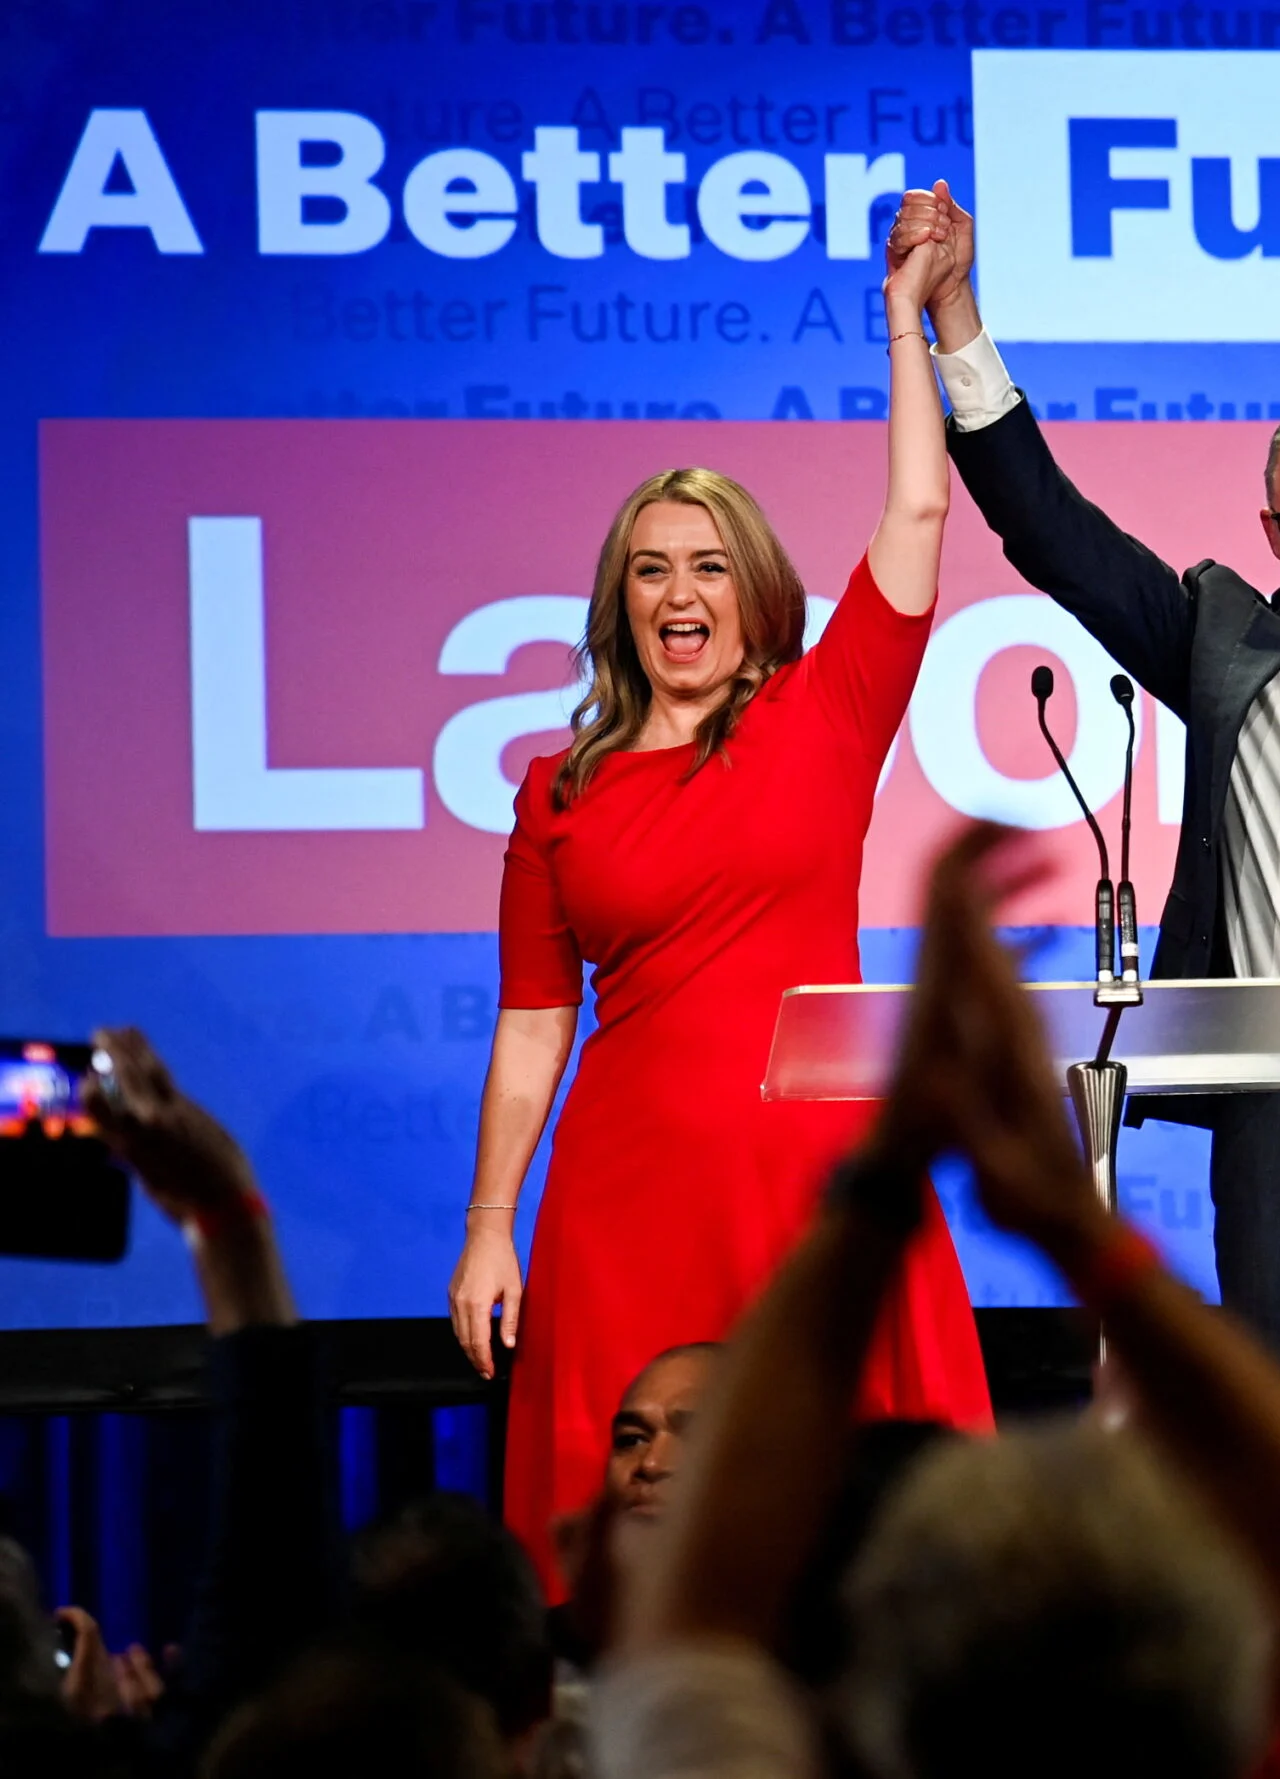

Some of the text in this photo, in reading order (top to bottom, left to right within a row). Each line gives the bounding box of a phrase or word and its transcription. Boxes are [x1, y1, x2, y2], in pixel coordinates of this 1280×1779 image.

[39, 108, 207, 256] A
[255, 108, 906, 263] Better
[527, 285, 770, 344] Future.
[792, 287, 844, 343] A
